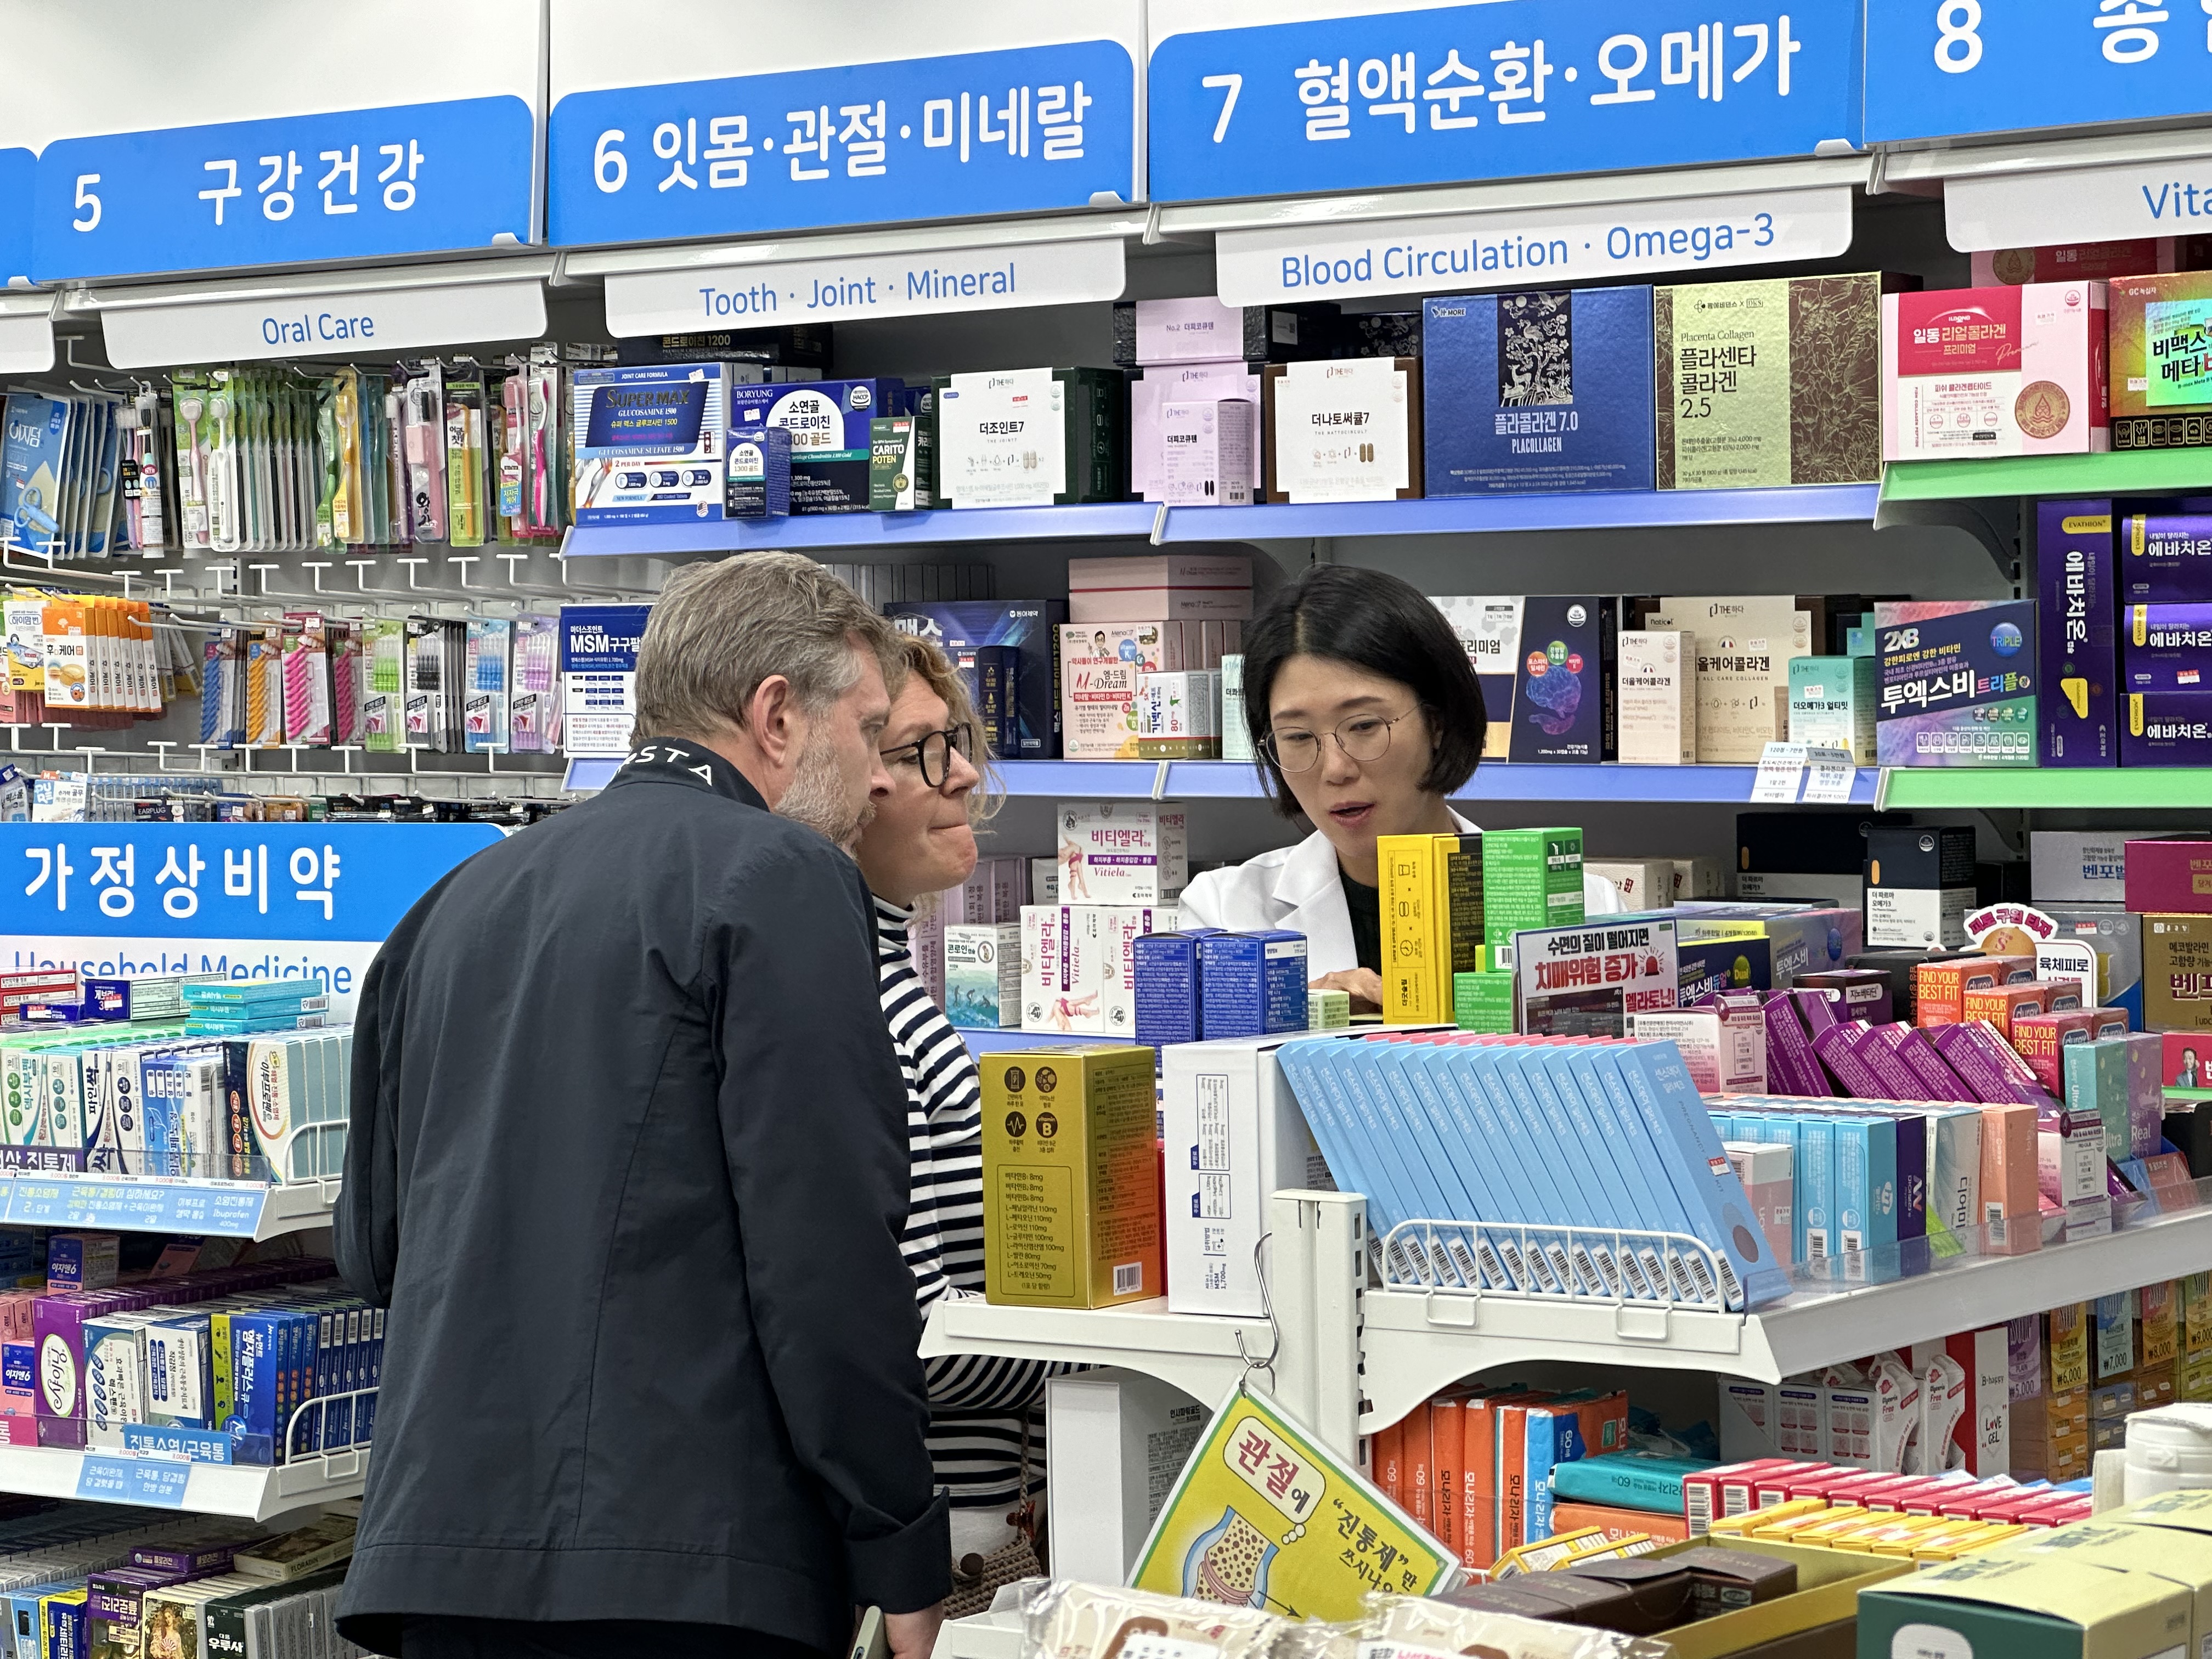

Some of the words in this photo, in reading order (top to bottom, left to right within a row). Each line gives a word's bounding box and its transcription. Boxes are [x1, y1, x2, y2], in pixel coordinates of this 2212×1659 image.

[1934, 0, 1983, 73] 8
[1202, 74, 1243, 143] 7
[594, 129, 628, 193] 6
[198, 139, 425, 225] 구강건강
[73, 174, 101, 232] 5
[1282, 249, 1372, 289] Blood
[1384, 236, 1568, 281] Circulation
[1607, 212, 1774, 261] Omega-3
[700, 283, 776, 316] Tooth
[807, 275, 876, 309] Joint
[907, 263, 1015, 301] Mineral
[262, 315, 312, 343] Oral
[318, 313, 375, 342] Care
[1681, 332, 1715, 342] Placenta
[1718, 330, 1754, 341] Collagen
[1914, 328, 1940, 344] 일동
[708, 334, 730, 346] 1200
[2153, 331, 2207, 359] 비맥스
[1680, 345, 1757, 370] 플라센타
[1944, 343, 1976, 356] 프리미엄
[1680, 370, 1737, 395] 콜라겐
[606, 390, 654, 408] SUPER
[657, 389, 690, 405] MAX
[737, 390, 773, 399] BORYUNG
[618, 409, 664, 417] GLUCOSAMINE
[789, 400, 820, 414] 소연골
[1680, 397, 1711, 418] 2.5
[1312, 412, 1369, 426] 더나토써큘7
[1494, 412, 1556, 434] 플라콜라겐
[1559, 411, 1578, 431] 7.0
[980, 421, 1024, 435] 더조인트7
[810, 432, 831, 446] 골드
[1512, 437, 1562, 454] PLACOLLAGEN
[599, 447, 645, 456] GLUCOSAMINE
[645, 446, 672, 454] SULFATE
[873, 444, 904, 456] CARITO
[873, 456, 896, 464] POTEN
[2069, 520, 2106, 528] EVATHION
[2148, 539, 2211, 557] 에바치온
[2066, 551, 2086, 641] 에바치온
[571, 625, 603, 634] 마더스조인트
[1884, 628, 1919, 652] 2XB
[2149, 630, 2211, 647] 에바치온
[1922, 647, 1937, 658] 강한
[1939, 643, 1961, 654] 비타민
[1622, 677, 1671, 686] 더올케어콜라겐
[2147, 724, 2206, 739] 에바치온
[1159, 815, 1184, 825] 비티엘라
[1092, 830, 1143, 847] 비티엘라
[1094, 867, 1125, 878] Vitiela
[25, 843, 341, 921] 가정상비약
[1969, 912, 1996, 935] 피로
[1996, 909, 2024, 924] 구원
[1548, 934, 1581, 956] 수면의
[1583, 933, 1604, 952] 질이
[1607, 928, 1649, 950] 떨어지면
[2169, 941, 2209, 953] 메코발라민
[1041, 922, 1054, 986] 비티엘라
[2169, 956, 2194, 967] 고함량
[1536, 956, 1601, 991] 치매위험
[1605, 953, 1638, 981] 증가
[1776, 948, 1809, 980] 투엑스비
[2040, 957, 2089, 972] 육체피로
[1734, 969, 1749, 980] Dual
[1920, 971, 1936, 984] FIND
[1938, 972, 1959, 984] YOUR
[1626, 988, 1675, 1013] 멜라토닌!
[1920, 985, 1944, 1000] BEST
[1946, 986, 1959, 1000] FIT
[1966, 997, 1983, 1010] FIND
[1985, 998, 2006, 1011] YOUR
[1966, 1012, 1990, 1023] BEST
[1992, 1012, 2006, 1028] FIT
[2015, 1026, 2032, 1038] FIND
[2034, 1026, 2056, 1039] YOUR
[2015, 1039, 2039, 1055] BEST
[2041, 1041, 2056, 1056] FIT
[1043, 1124, 1052, 1136] B
[2131, 1126, 2150, 1140] Real
[26, 1153, 76, 1172] 진통제
[212, 1211, 249, 1219] Ibuprofen
[2148, 1342, 2170, 1360] ₩8,000
[2104, 1353, 2126, 1370] ₩7,000
[2057, 1368, 2081, 1386] ₩6,000
[2009, 1380, 2034, 1398] ₩5,000
[1989, 1432, 1999, 1444] GEL
[1442, 1470, 1451, 1516] 모나리자
[1465, 1471, 1475, 1519] 모나리자
[1509, 1474, 1520, 1521] 모나리자
[1535, 1481, 1545, 1527] 모나리자
[209, 1637, 244, 1654] 우루사
